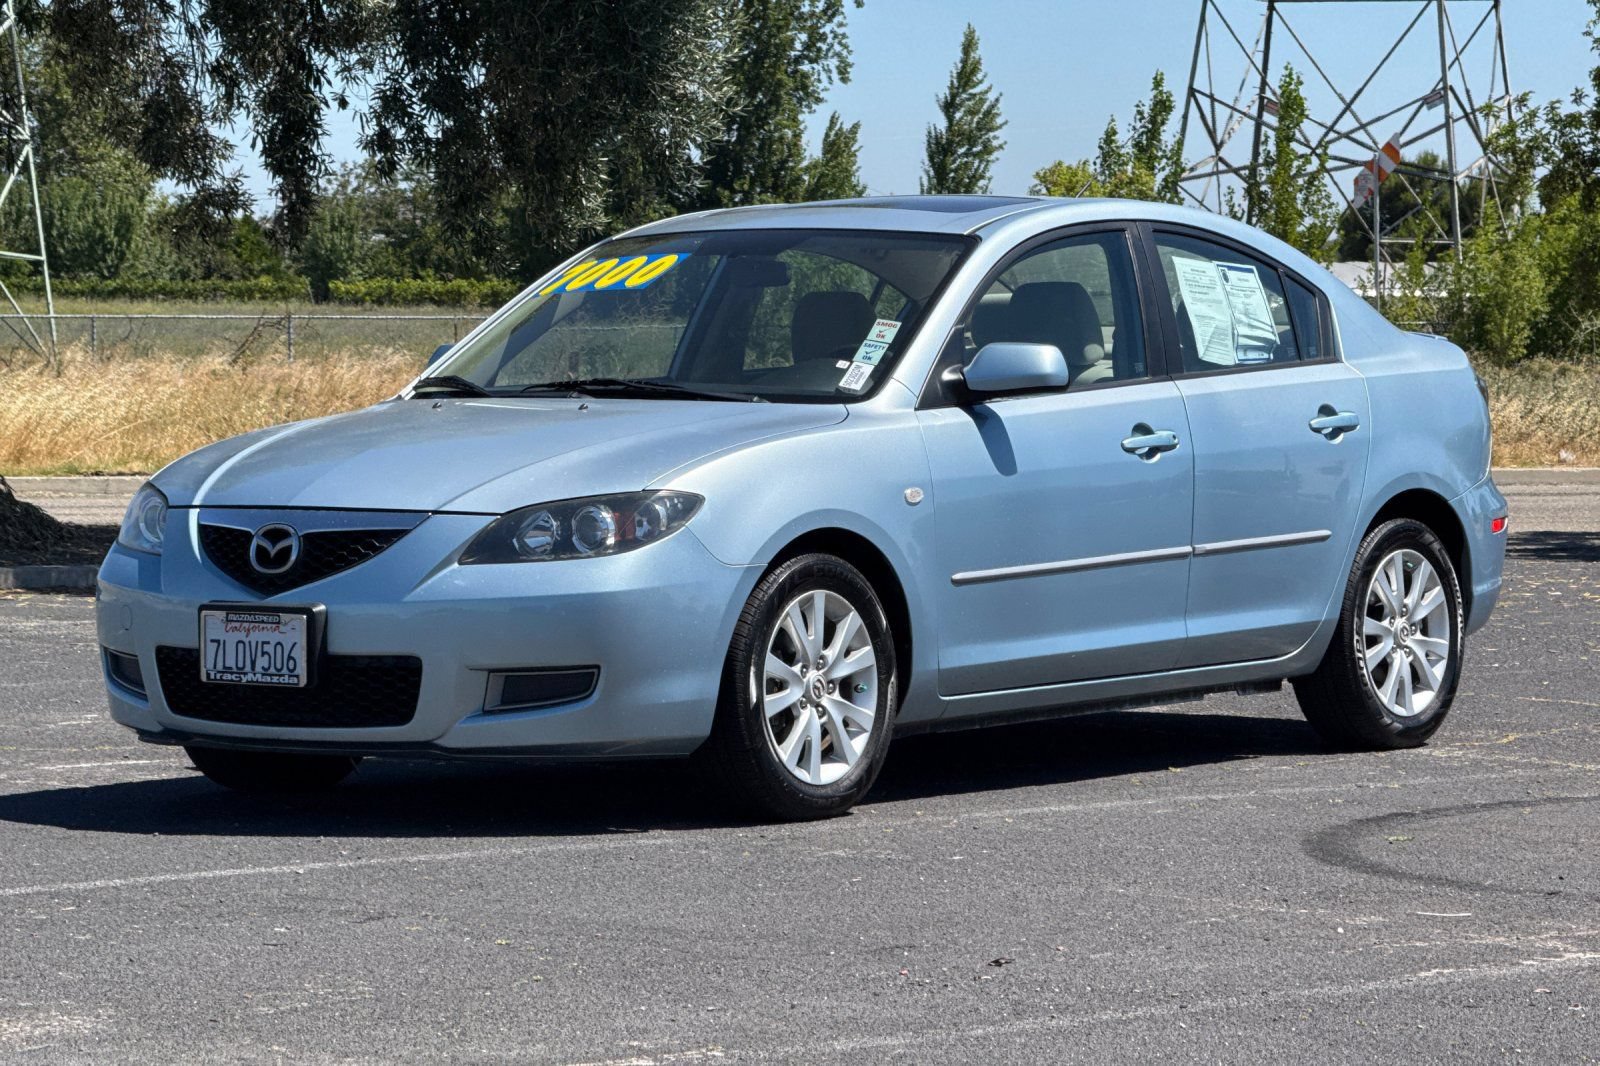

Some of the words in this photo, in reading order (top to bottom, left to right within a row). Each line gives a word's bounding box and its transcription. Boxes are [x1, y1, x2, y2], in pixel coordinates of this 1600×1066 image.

[539, 254, 678, 296] 7000
[228, 614, 279, 623] MAZDASPEED
[224, 623, 287, 638] California
